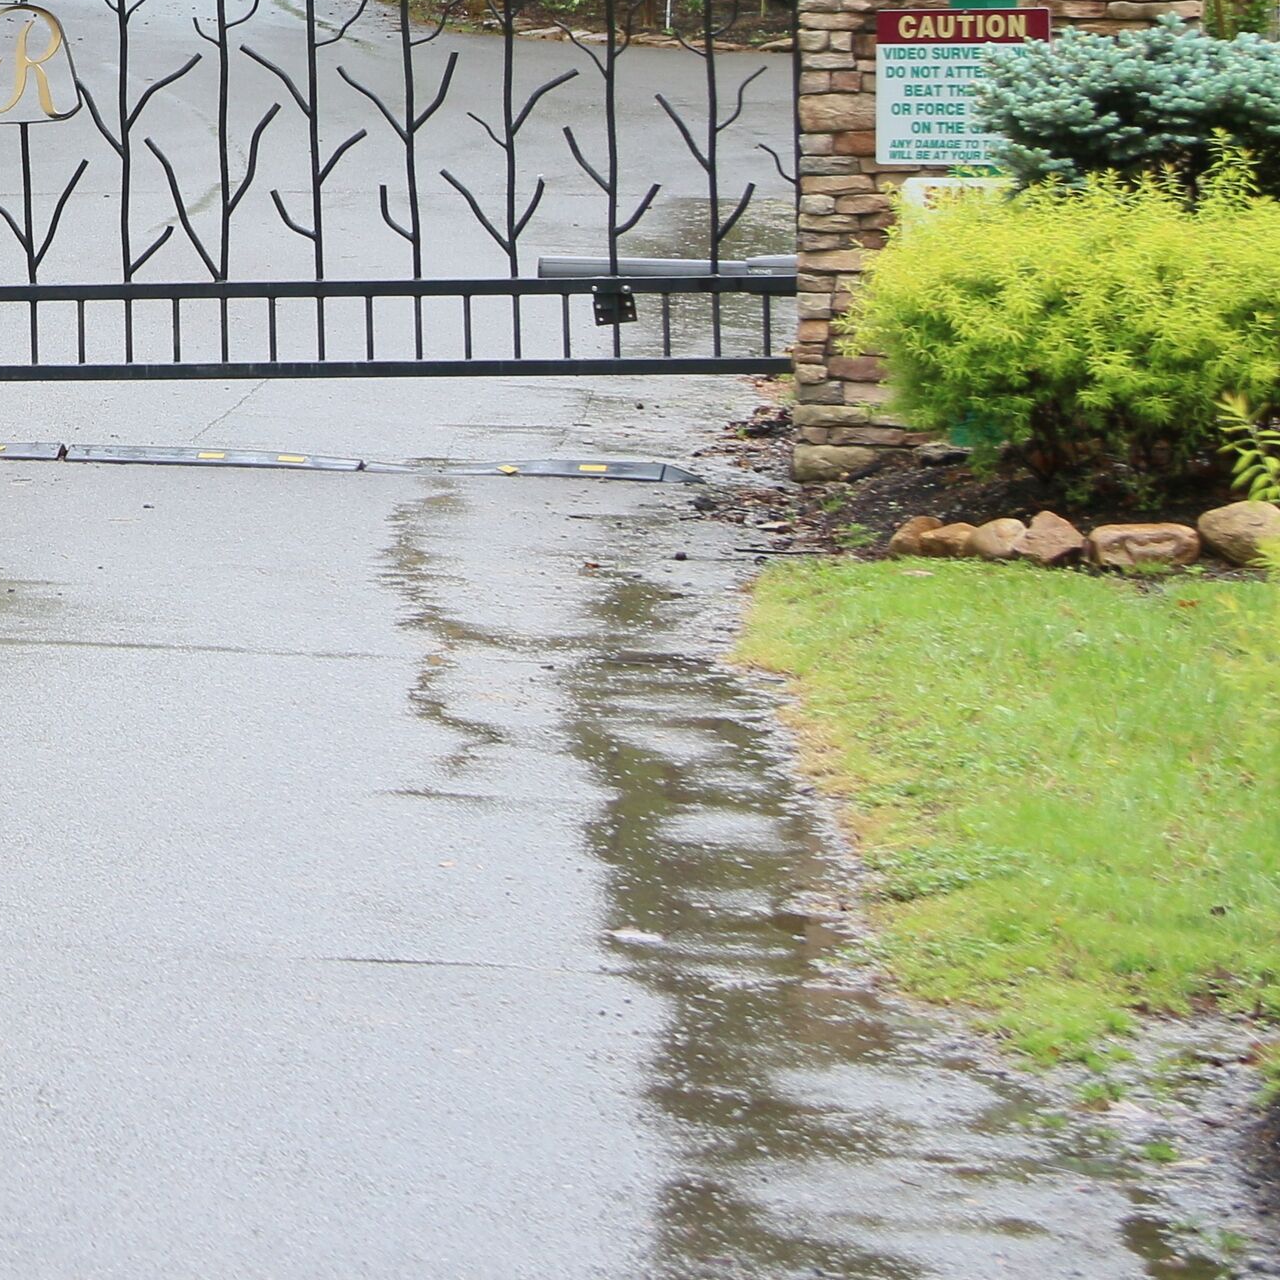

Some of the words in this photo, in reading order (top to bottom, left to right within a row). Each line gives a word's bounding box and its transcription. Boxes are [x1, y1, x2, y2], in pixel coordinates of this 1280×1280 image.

[897, 14, 1026, 39] CAUTION
[883, 46, 928, 61] VIDEO
[885, 65, 906, 79] DO
[910, 65, 940, 79] NOT
[945, 65, 988, 79] ATTE
[904, 84, 943, 97] BEAT
[891, 102, 912, 116] OR
[916, 102, 965, 116] FORCE
[911, 121, 931, 135] ON
[936, 121, 965, 135] THE
[889, 139, 912, 149] ANY
[914, 139, 961, 149] DAMAGE
[965, 140, 980, 149] TO
[889, 150, 913, 160] WILL
[916, 150, 930, 160] BE
[933, 150, 948, 160] AT
[951, 150, 983, 160] YOUR
